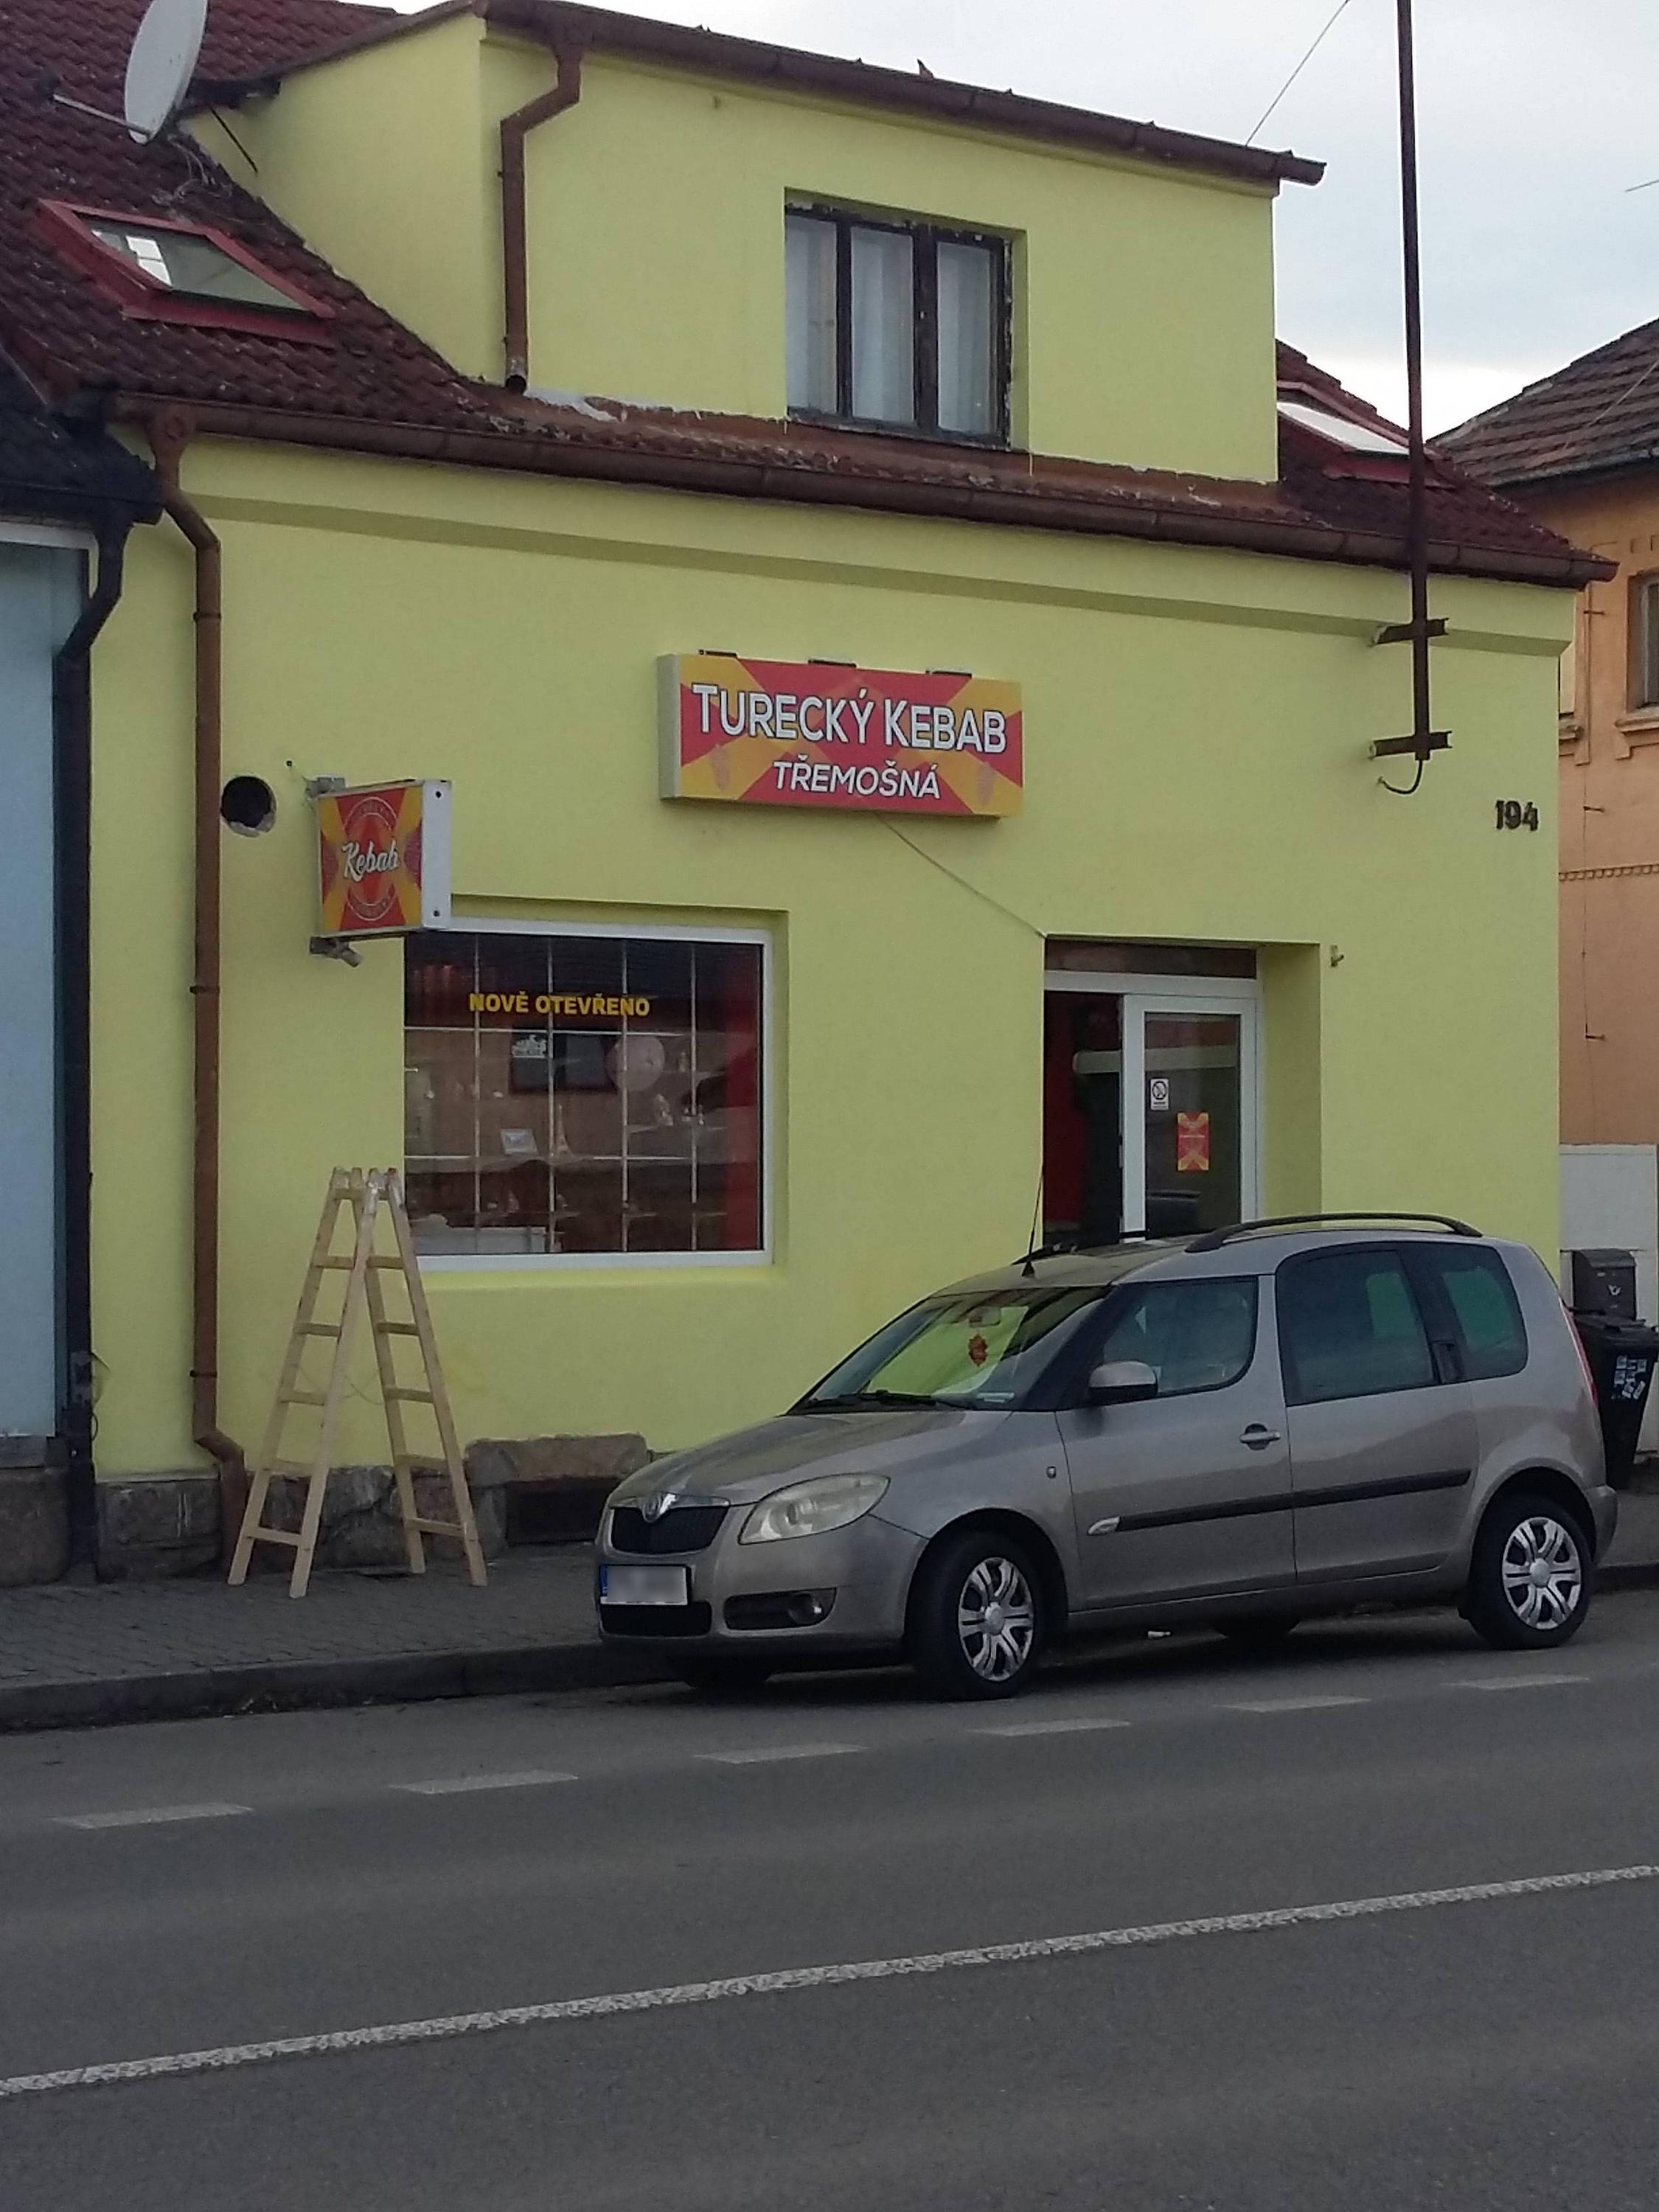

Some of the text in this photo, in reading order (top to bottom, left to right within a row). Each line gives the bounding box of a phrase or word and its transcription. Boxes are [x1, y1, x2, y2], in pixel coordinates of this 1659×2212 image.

[692, 683, 1007, 754] TURECKÝ KEBAB
[773, 754, 941, 799] TŘEMOŠNÁ
[1495, 800, 1539, 831] 194
[342, 840, 399, 883] Kebab
[469, 991, 650, 1016] NOVĚ OTEVŘENO
